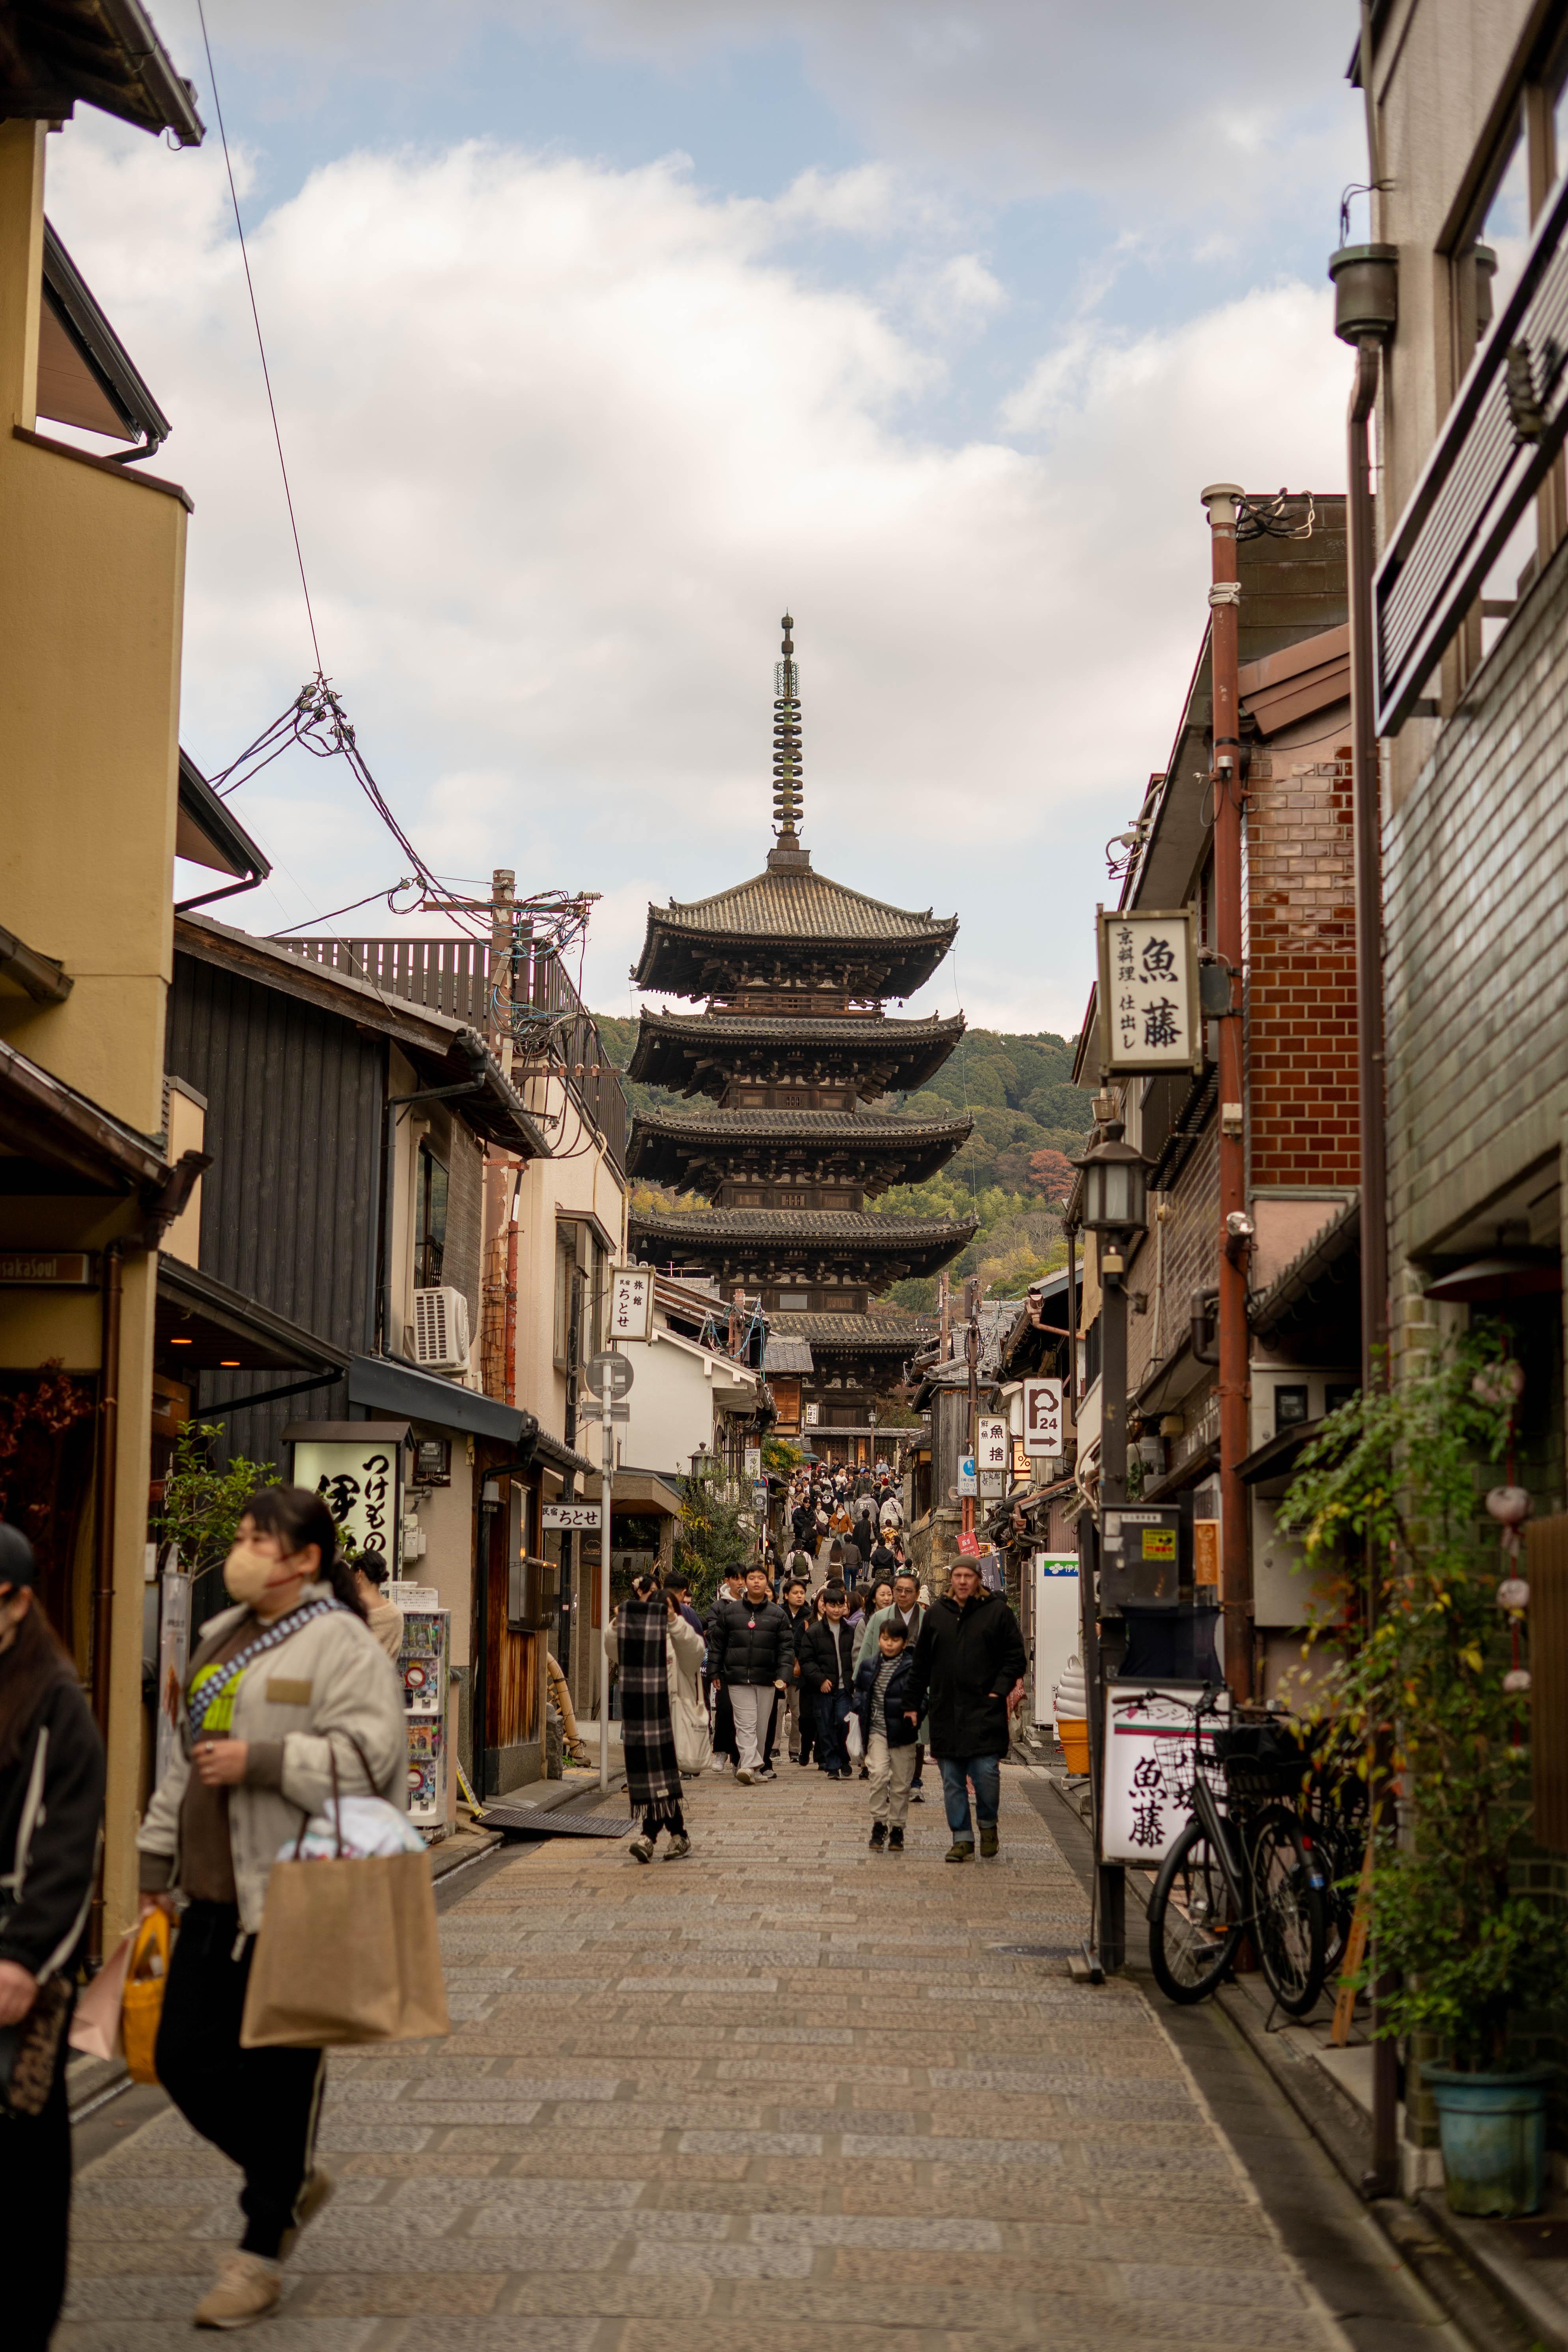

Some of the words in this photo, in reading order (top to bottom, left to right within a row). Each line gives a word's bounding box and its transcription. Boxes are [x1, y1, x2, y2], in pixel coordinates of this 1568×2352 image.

[1116, 927, 1135, 1049] 京料理・仕出し
[1139, 936, 1182, 1048] 魚藤
[0, 1258, 57, 1277] sakaSoul
[617, 1288, 630, 1327] ちとせ
[633, 1280, 644, 1305] 旅館
[981, 1420, 989, 1439] 鮮魚
[1040, 1418, 1058, 1429] 24
[989, 1425, 1004, 1461] 魚捨
[362, 1455, 389, 1551] つけもの
[542, 1507, 558, 1516] 民宿
[560, 1510, 598, 1525] ちとせ
[1129, 1756, 1167, 1848] 魚藤
